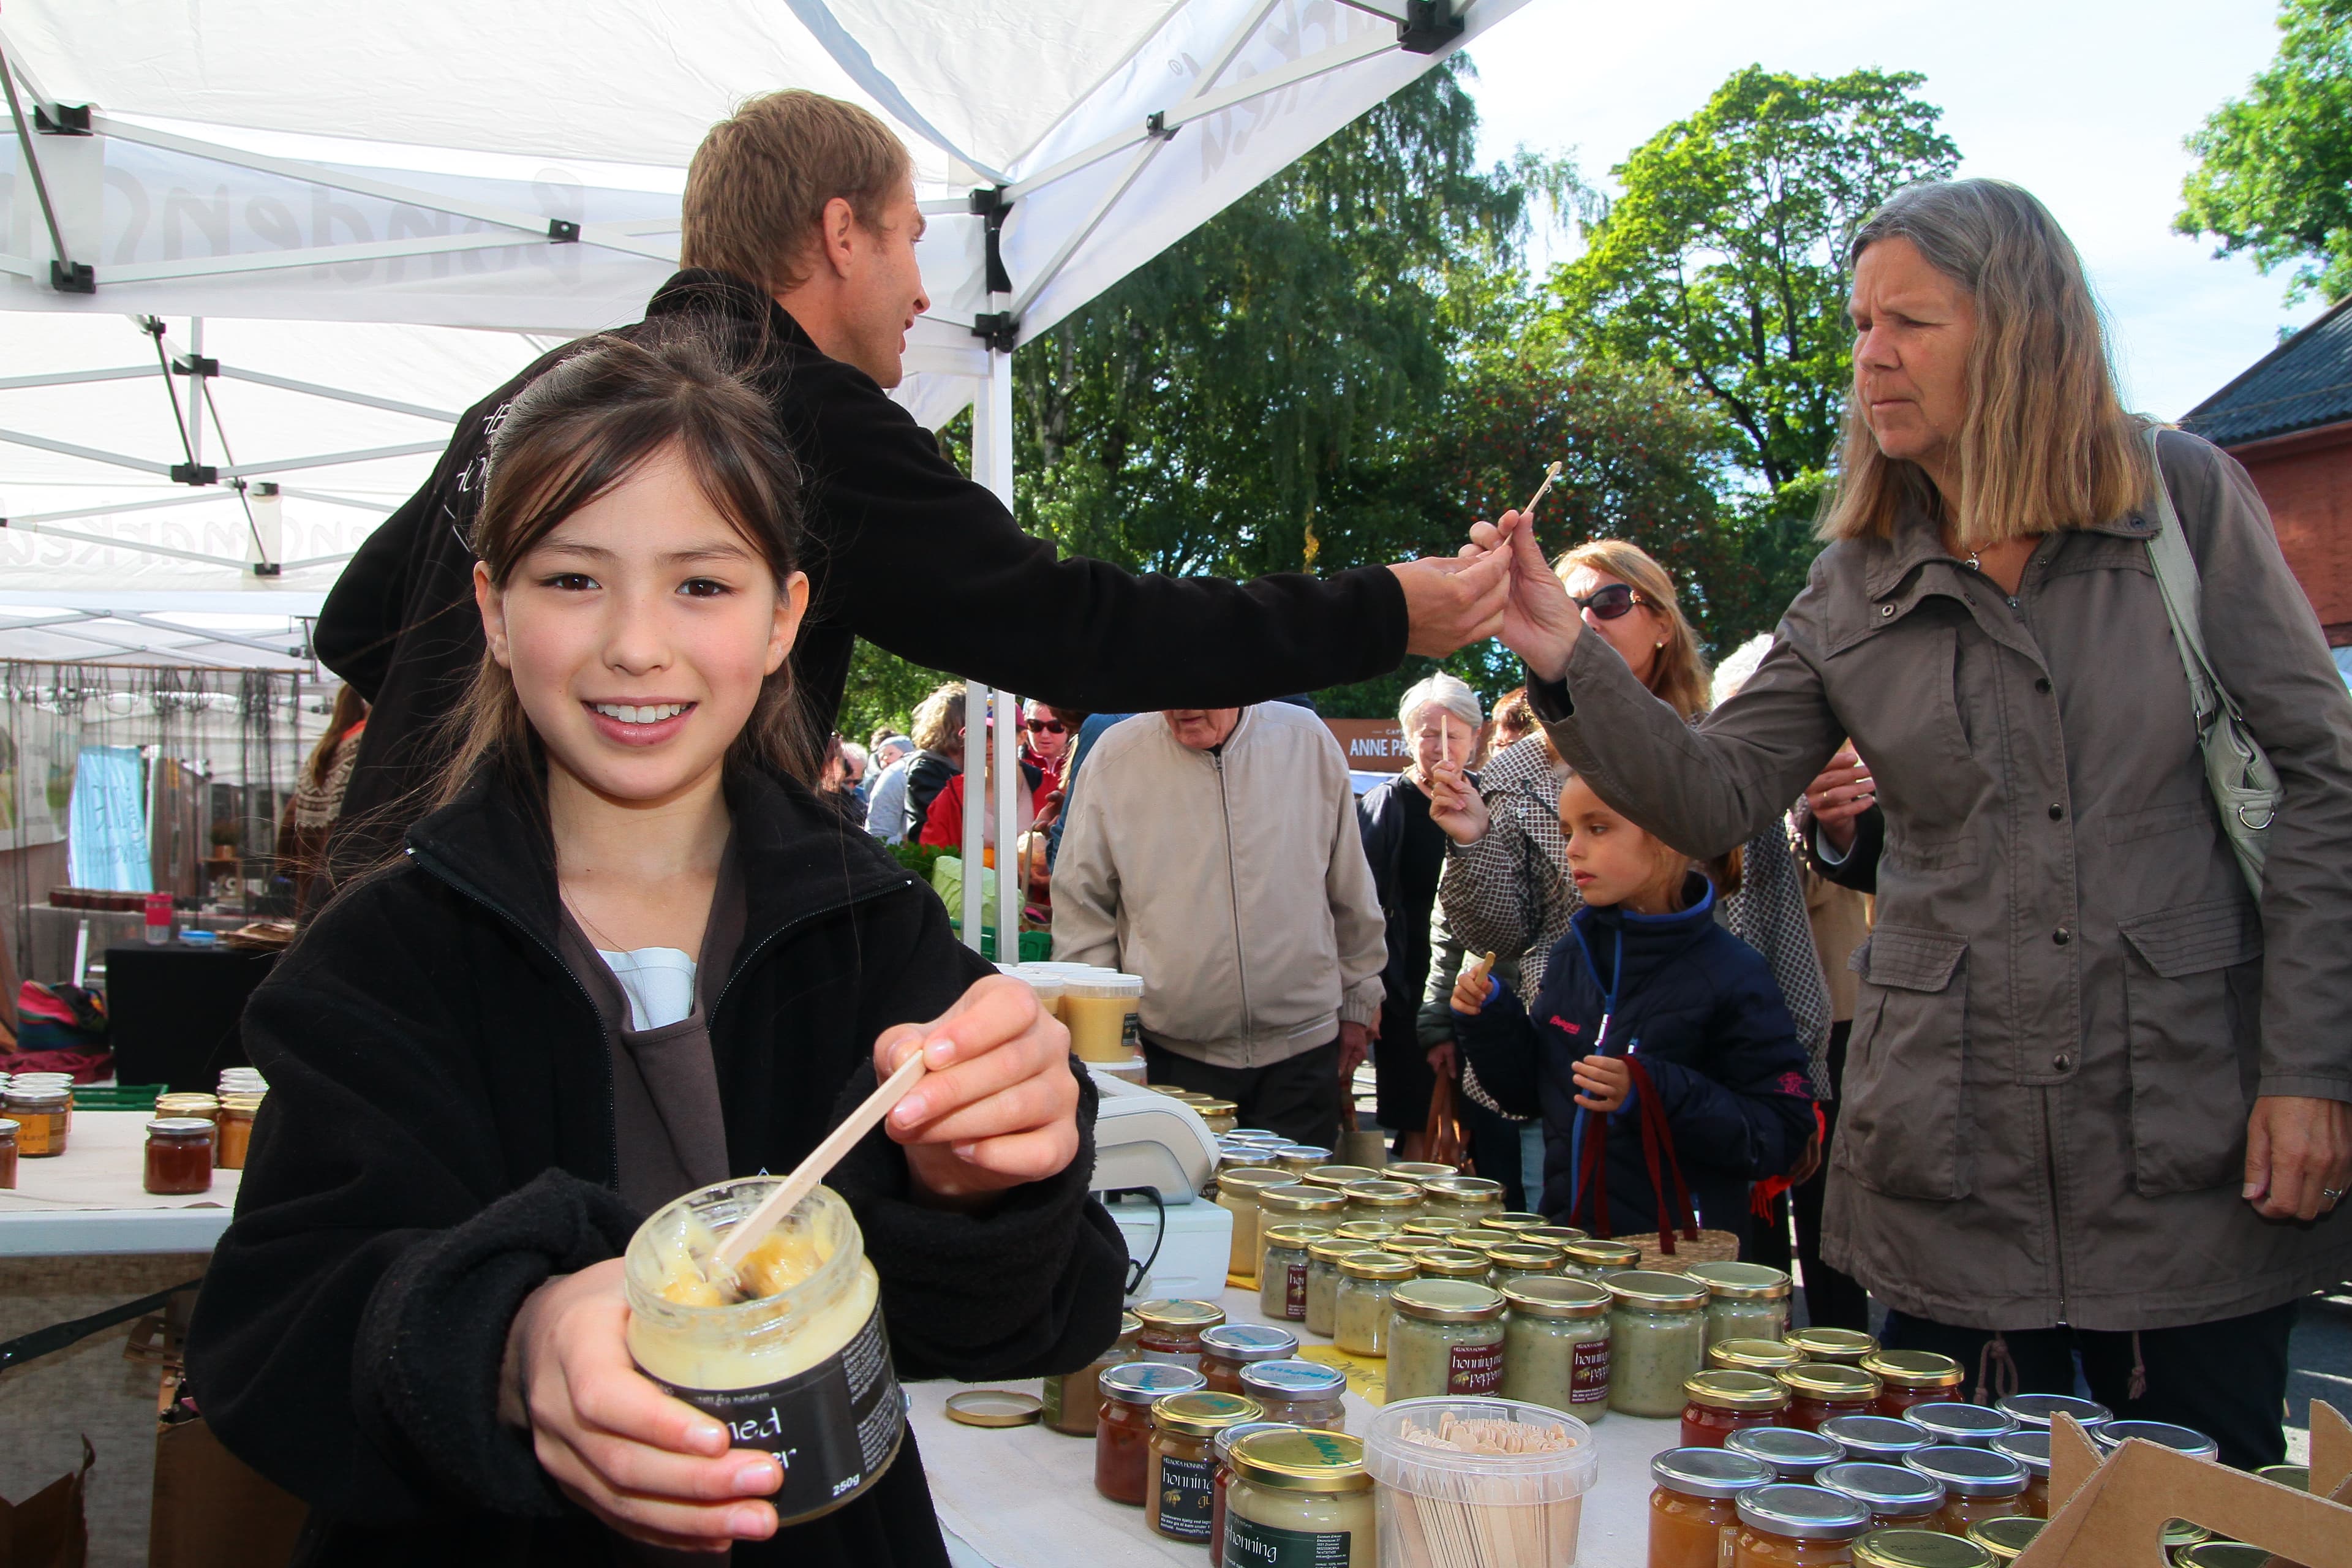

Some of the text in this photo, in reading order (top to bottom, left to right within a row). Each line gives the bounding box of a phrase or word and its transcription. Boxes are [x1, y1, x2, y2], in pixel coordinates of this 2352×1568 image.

[1349, 738, 1389, 756] ANNE
[1452, 1355, 1493, 1371] honning
[832, 1473, 860, 1496] 250g
[1163, 1467, 1213, 1494] honning
